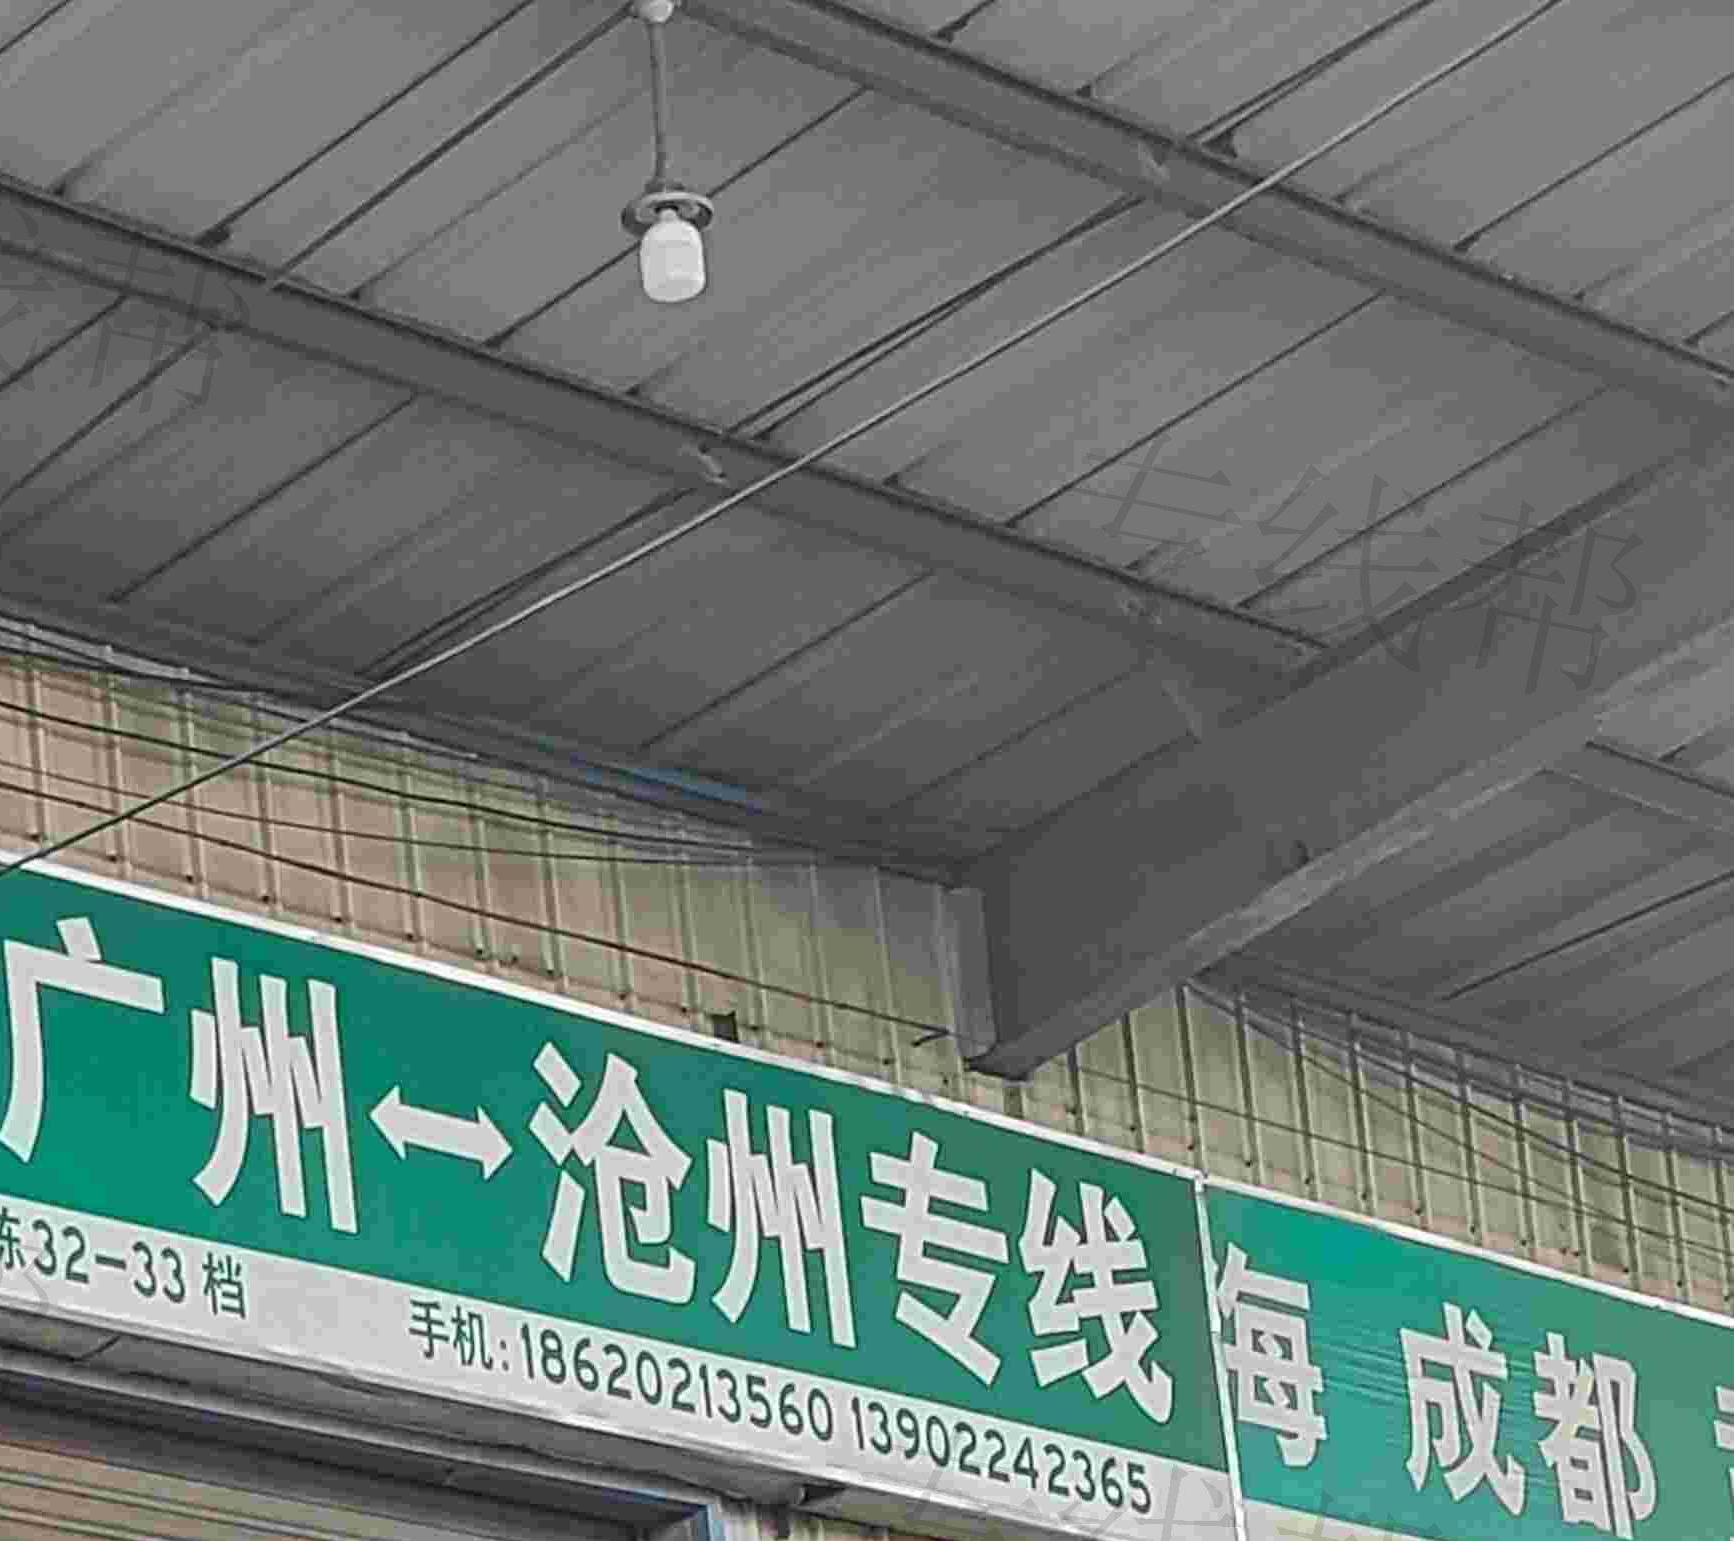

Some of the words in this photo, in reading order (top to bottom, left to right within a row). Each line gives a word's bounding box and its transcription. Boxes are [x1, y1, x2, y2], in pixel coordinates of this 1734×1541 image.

[528, 1041, 1173, 1424] 沧州专线
[409, 1299, 834, 1443] 手机:18620213560
[851, 1400, 1153, 1515] 13902242365
